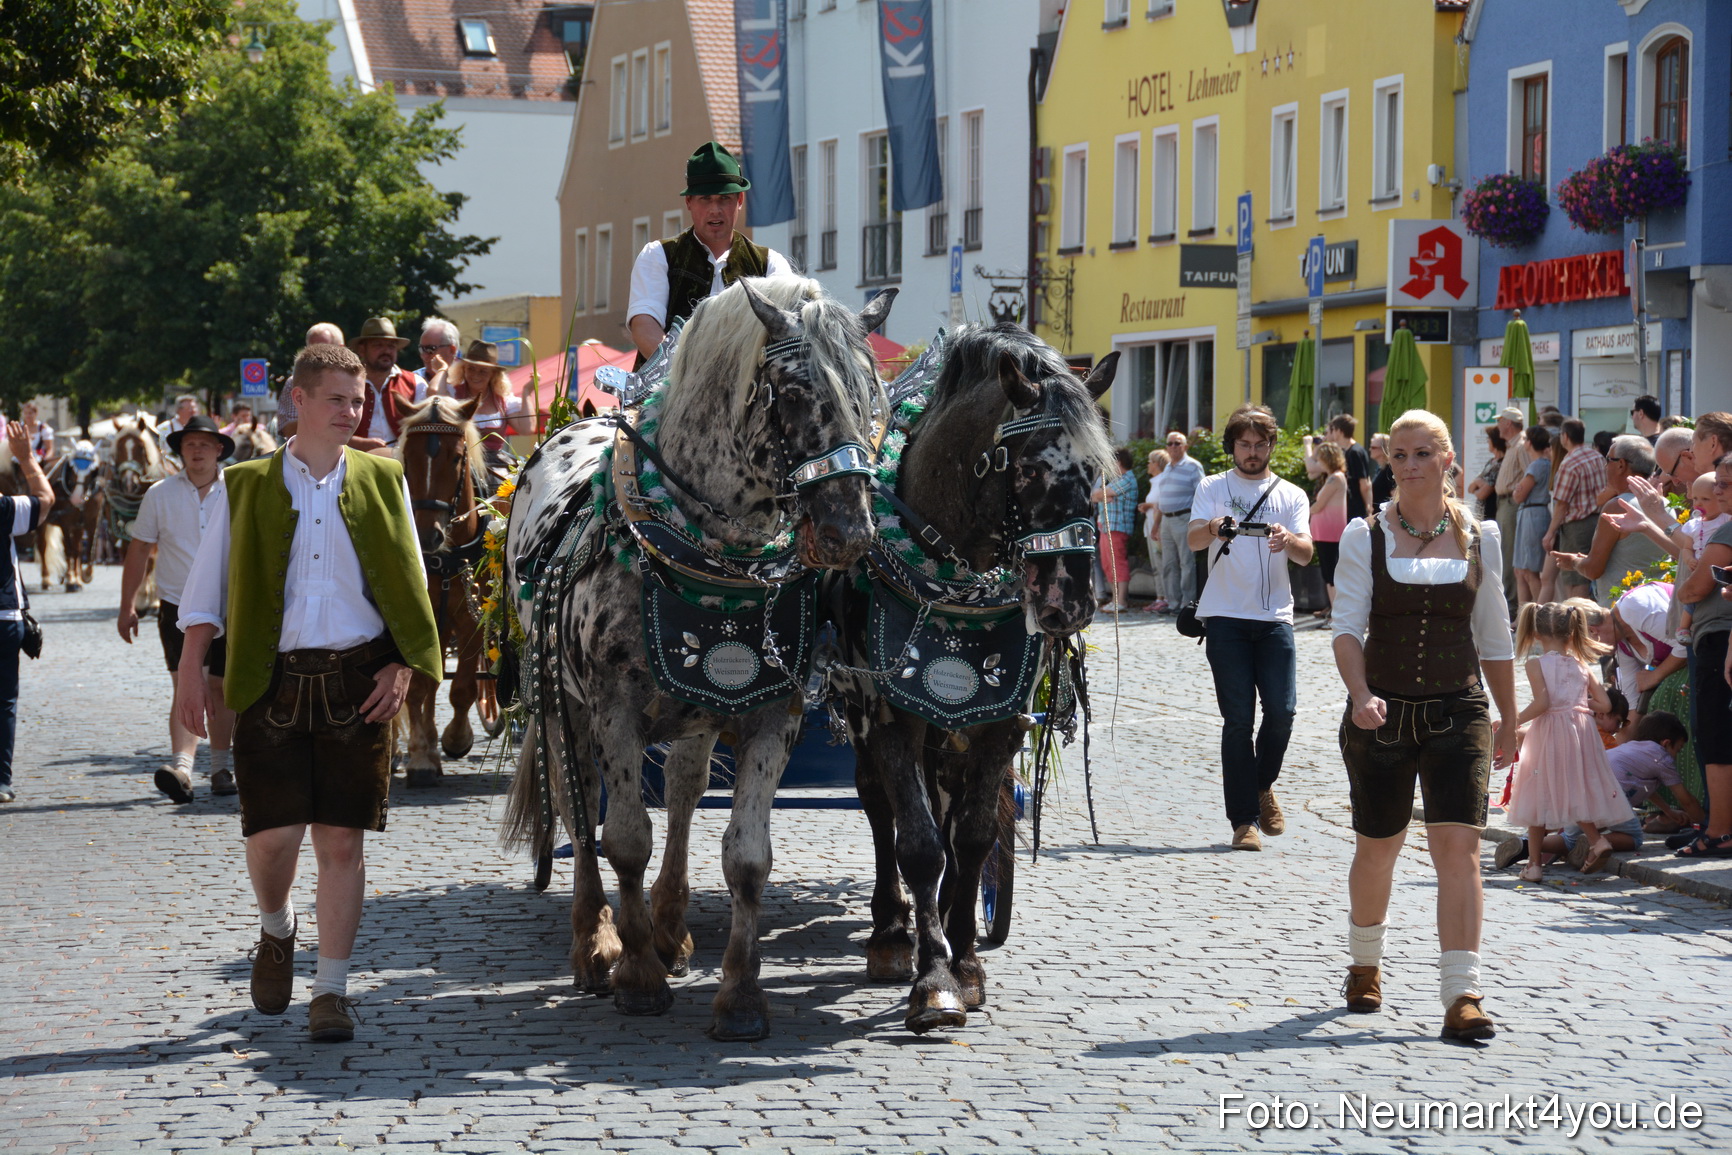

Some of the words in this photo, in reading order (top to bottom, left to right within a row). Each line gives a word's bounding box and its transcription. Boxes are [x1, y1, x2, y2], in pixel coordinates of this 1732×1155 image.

[1128, 70, 1174, 119] HOTEL
[1187, 61, 1241, 102] Lehmeier
[1312, 245, 1321, 291] P
[1494, 250, 1620, 311] APOTHEKE
[1120, 291, 1186, 323] Restaurant
[1585, 334, 1615, 350] RATHAUS
[713, 656, 751, 664] Holzrückerei
[933, 669, 971, 681] Holzrückerei
[933, 680, 968, 692] Weismann
